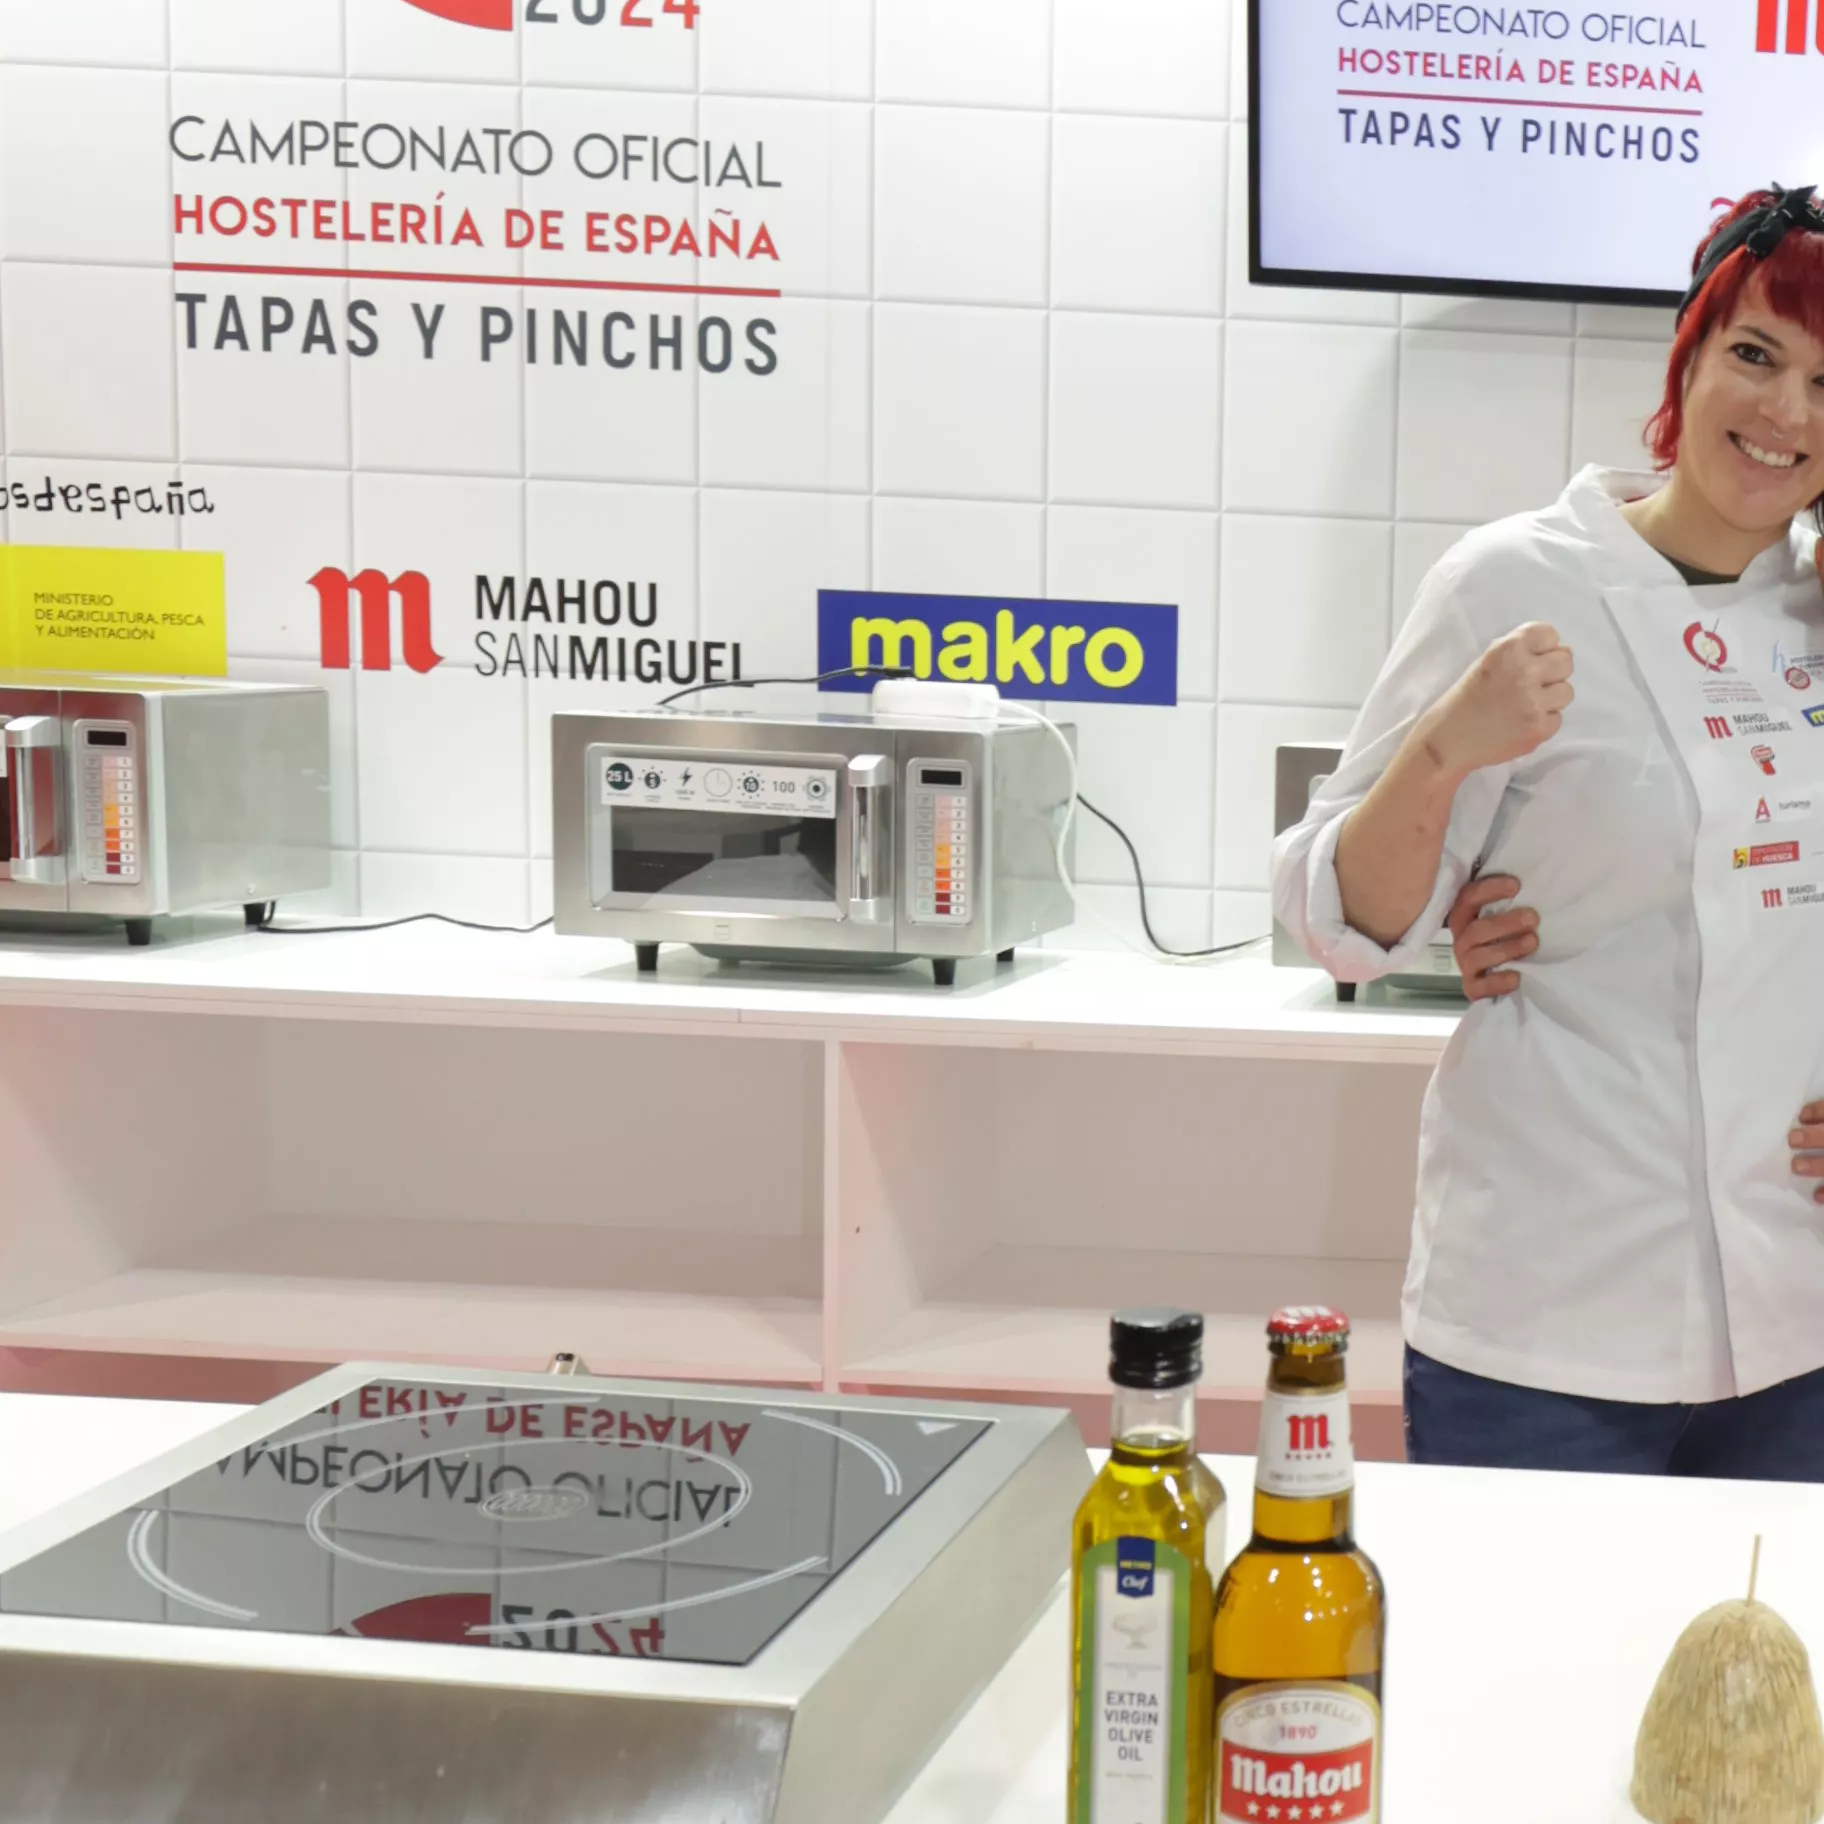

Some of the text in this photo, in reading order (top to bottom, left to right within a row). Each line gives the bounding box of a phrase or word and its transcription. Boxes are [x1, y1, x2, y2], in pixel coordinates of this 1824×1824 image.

[1336, 0, 1706, 49] CAMPEONATO OFICIAL
[1337, 47, 1703, 92] HOSTELERÍA DE ESPAÑA
[1338, 109, 1701, 164] TAPAS Y PINCHOS
[169, 115, 782, 188] CAMPEONATO OFICIAL
[173, 192, 781, 262] HOSTELERÍA DE ESPAÑA
[175, 292, 779, 377] TAPAS Y PINCHOS
[34, 592, 114, 607] MINISTERIO
[475, 575, 657, 627] MAHOU
[35, 609, 53, 621] DE
[161, 613, 205, 626] PESCA
[35, 625, 155, 640] Y ALIMENTACIÓN
[850, 609, 1145, 692] makro
[1733, 713, 1769, 725] MAHOU
[607, 770, 622, 782] 25
[772, 780, 796, 794] 100
[1106, 1691, 1158, 1707] EXTRA
[1105, 1709, 1158, 1725] VIRGIN
[1108, 1727, 1153, 1743] OLIVE
[1280, 1726, 1317, 1739] 1890
[1118, 1746, 1143, 1761] OIL
[1231, 1754, 1362, 1799] Mahou
